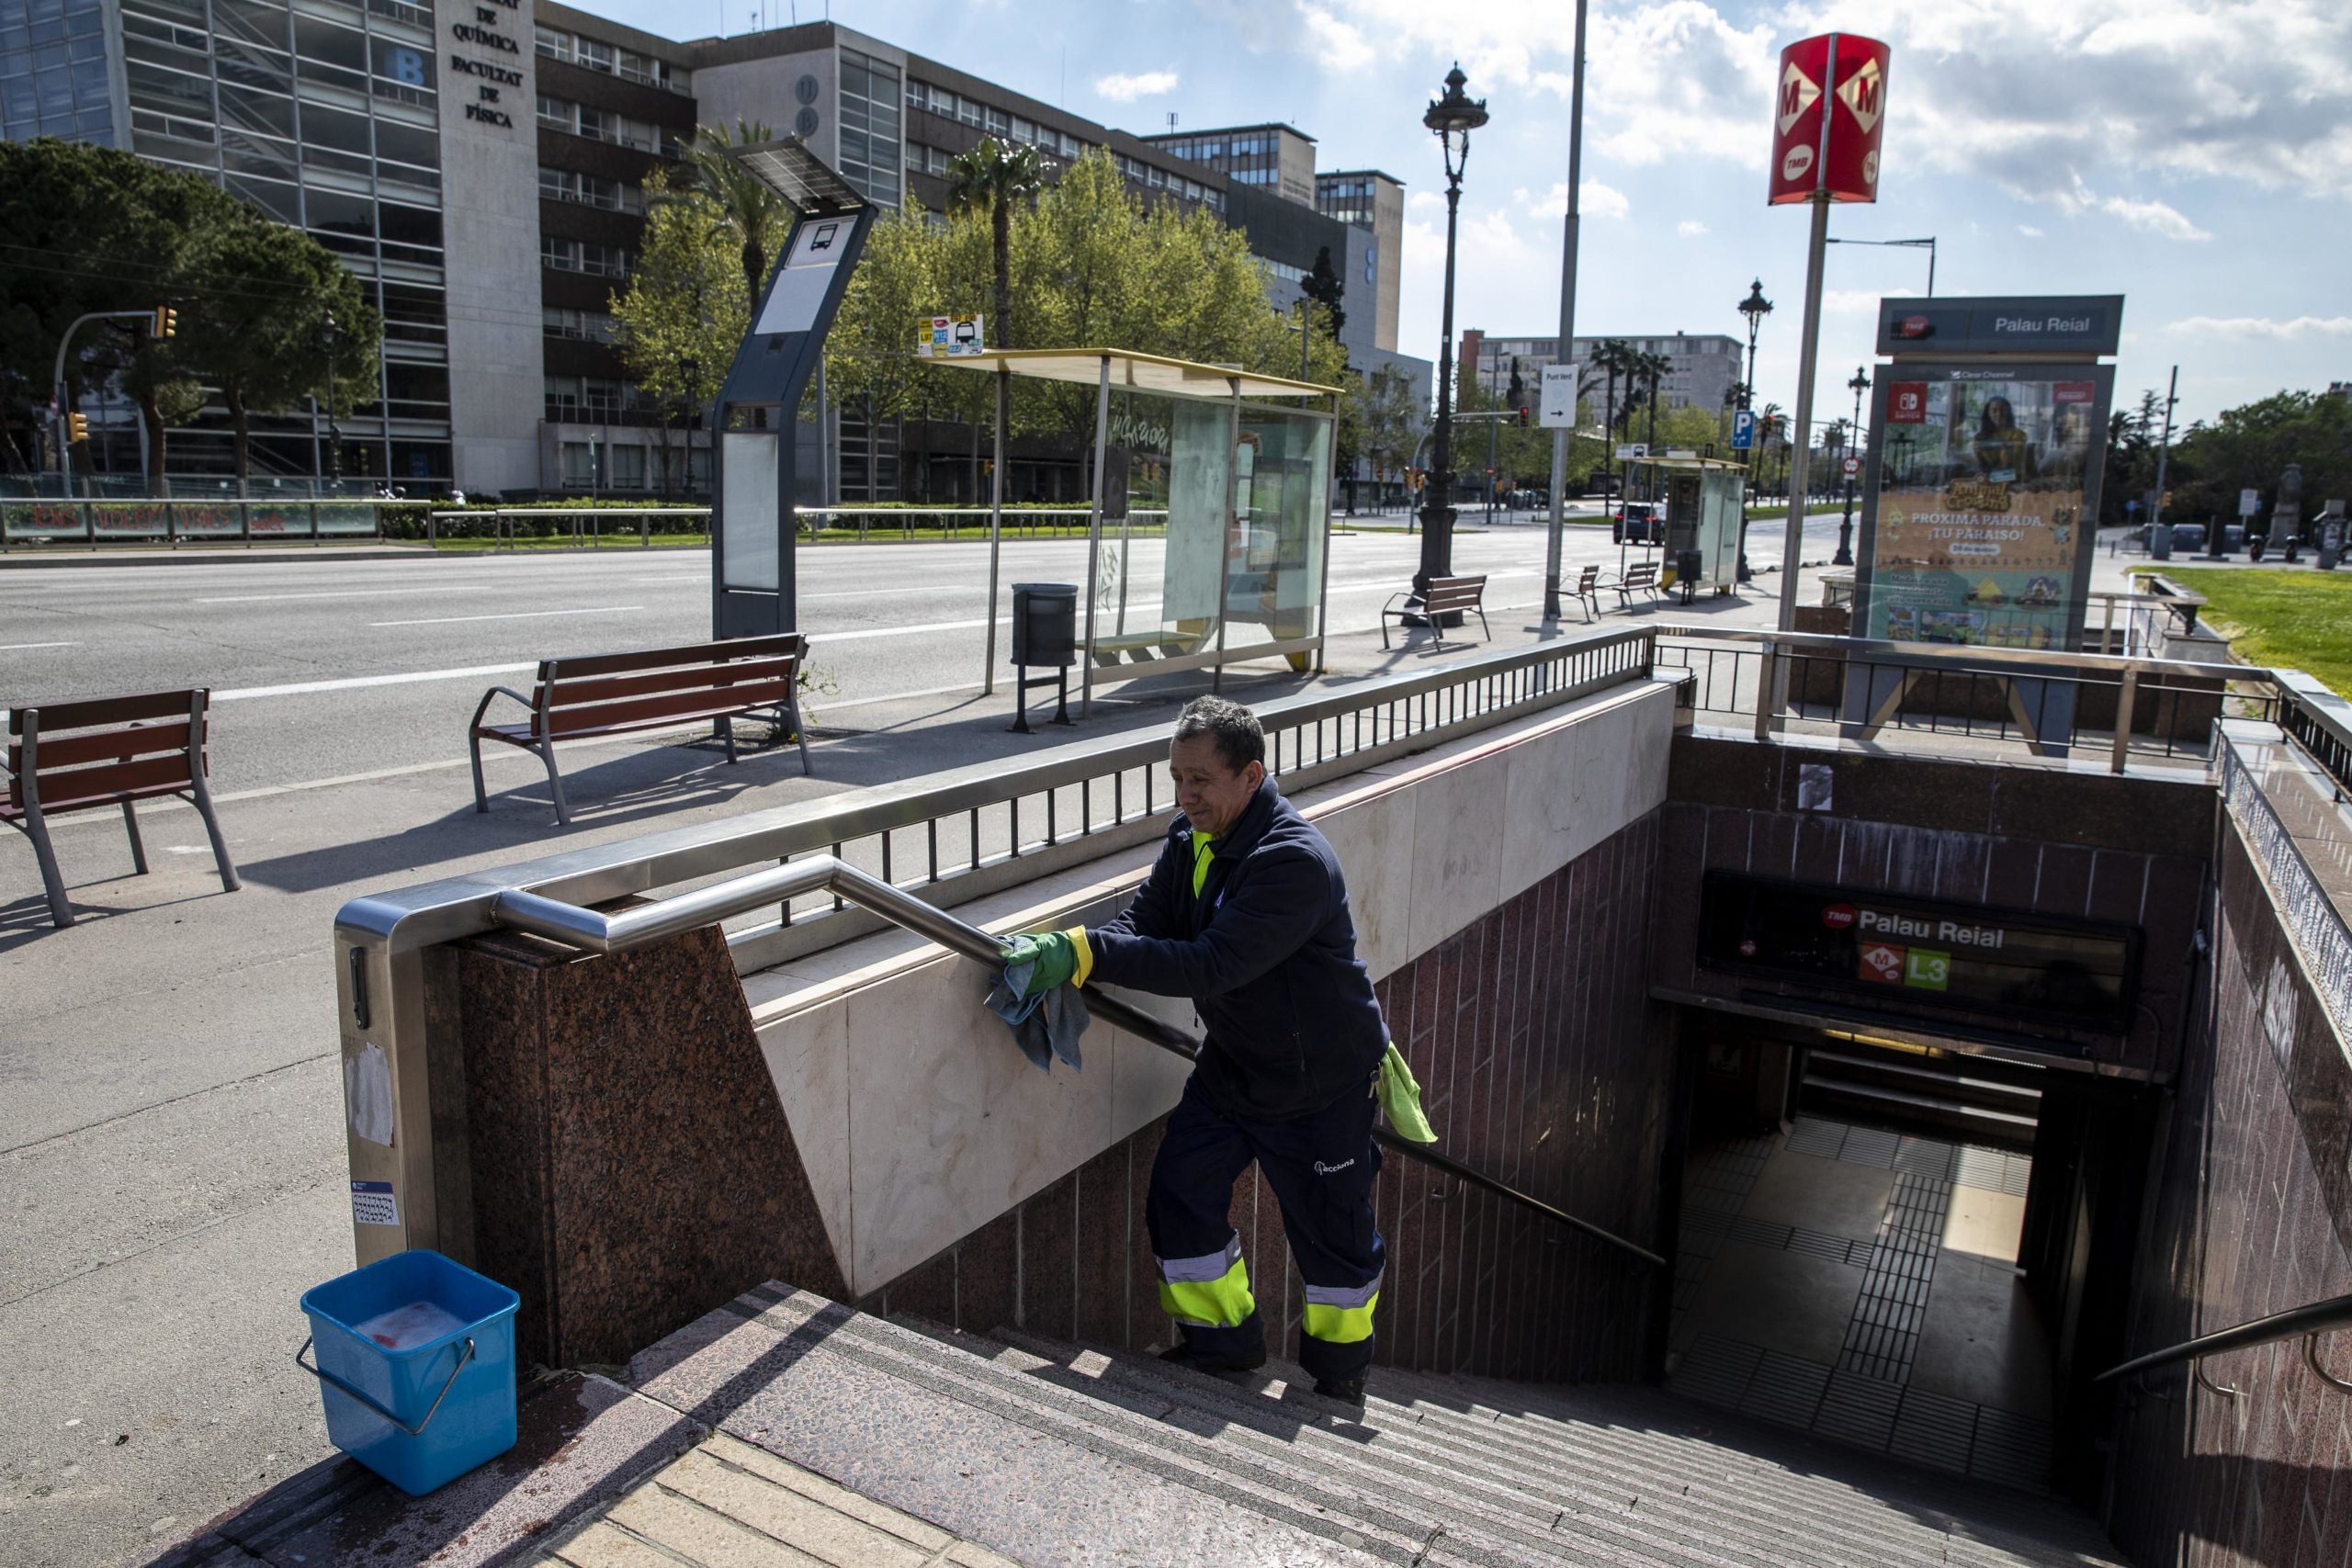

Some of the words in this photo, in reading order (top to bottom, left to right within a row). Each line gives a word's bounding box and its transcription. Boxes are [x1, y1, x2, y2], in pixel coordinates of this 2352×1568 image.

[476, 6, 497, 26] DE
[452, 23, 520, 55] QUÍMICA
[451, 54, 524, 87] FACULTAT
[479, 85, 500, 104] DE
[1780, 79, 1802, 119] M
[1857, 76, 1880, 116] M
[465, 103, 513, 130] FÍSICA
[1787, 156, 1809, 170] TMB
[1995, 317, 2042, 333] Palau
[2047, 316, 2090, 332] Reial
[1736, 413, 1750, 434] P
[1827, 911, 1852, 922] TMB
[1859, 910, 1930, 939] Palau
[1938, 920, 2005, 949] Reial
[1874, 953, 1890, 966] M
[1910, 954, 1948, 983] L3
